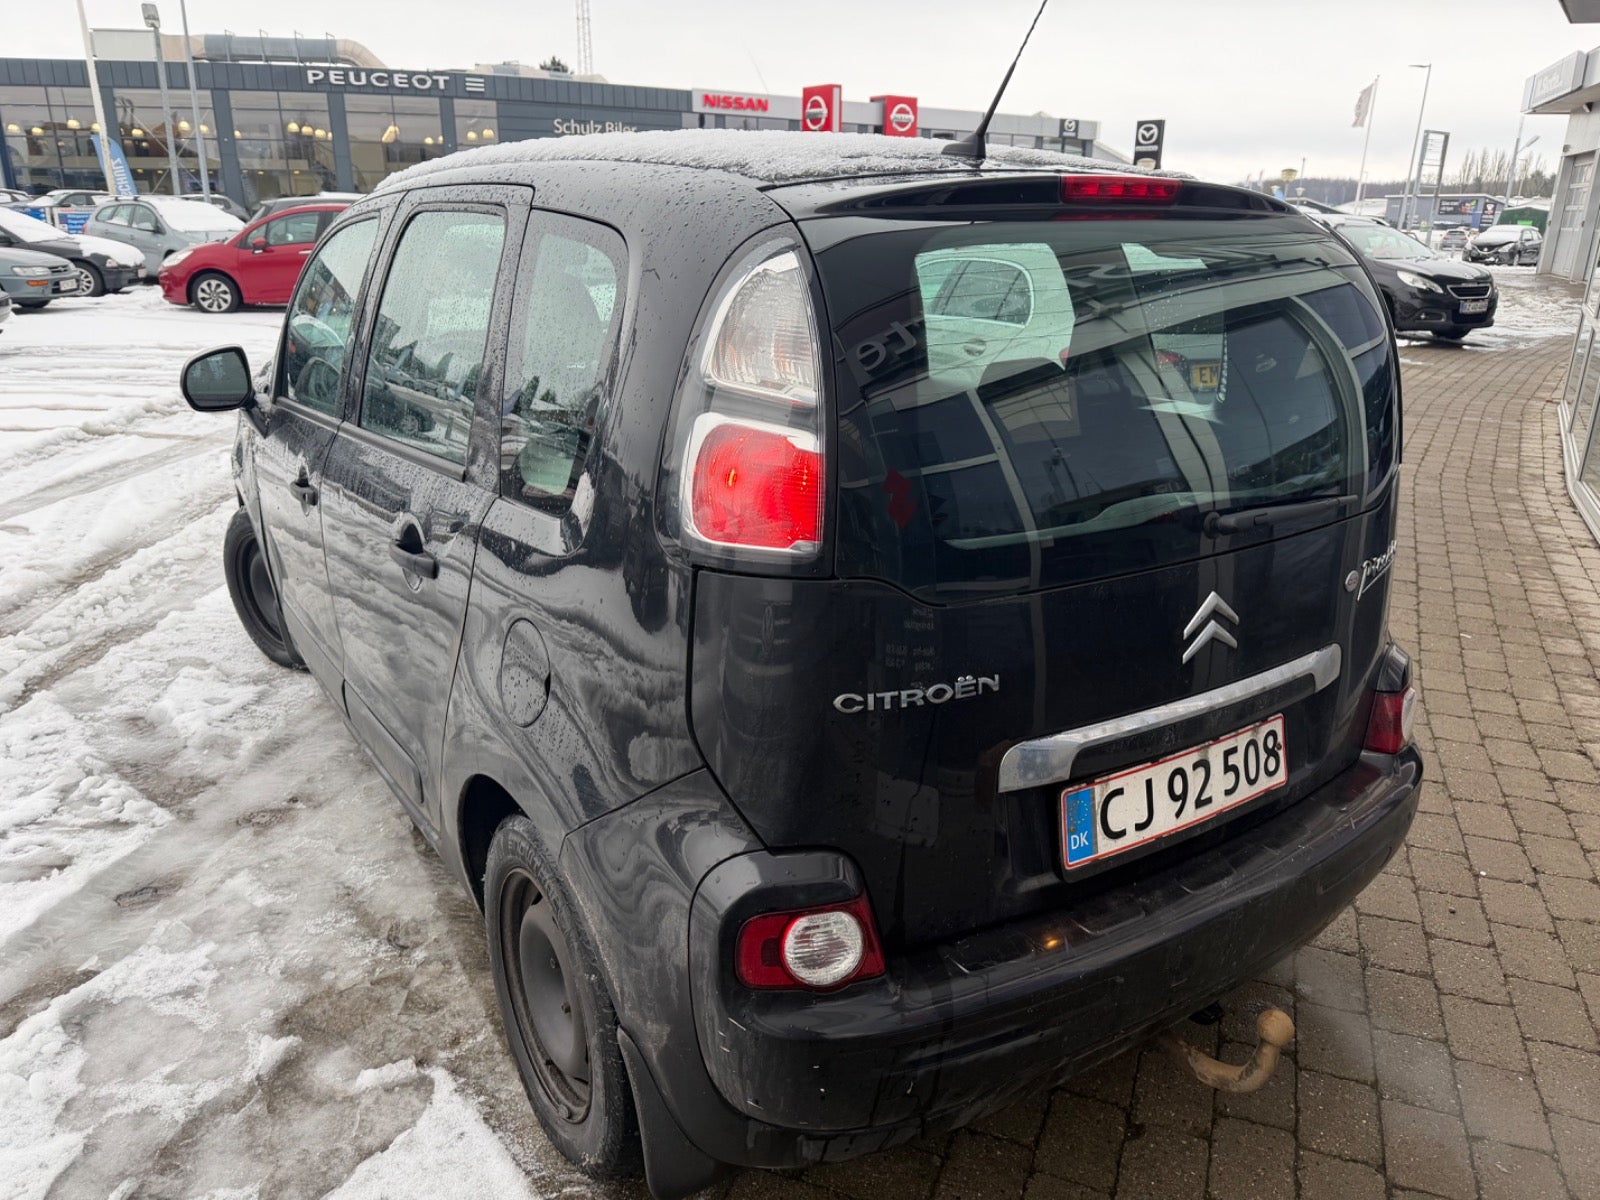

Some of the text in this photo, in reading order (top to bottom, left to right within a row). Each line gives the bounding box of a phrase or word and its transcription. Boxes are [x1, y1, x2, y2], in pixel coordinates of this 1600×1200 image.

[306, 70, 450, 90] PEUGEOT
[702, 93, 769, 113] NISSAN
[553, 118, 603, 135] Schulz
[832, 673, 1000, 714] CITROËN
[1099, 729, 1282, 840] CJ 92 508
[1070, 831, 1089, 851] DK
